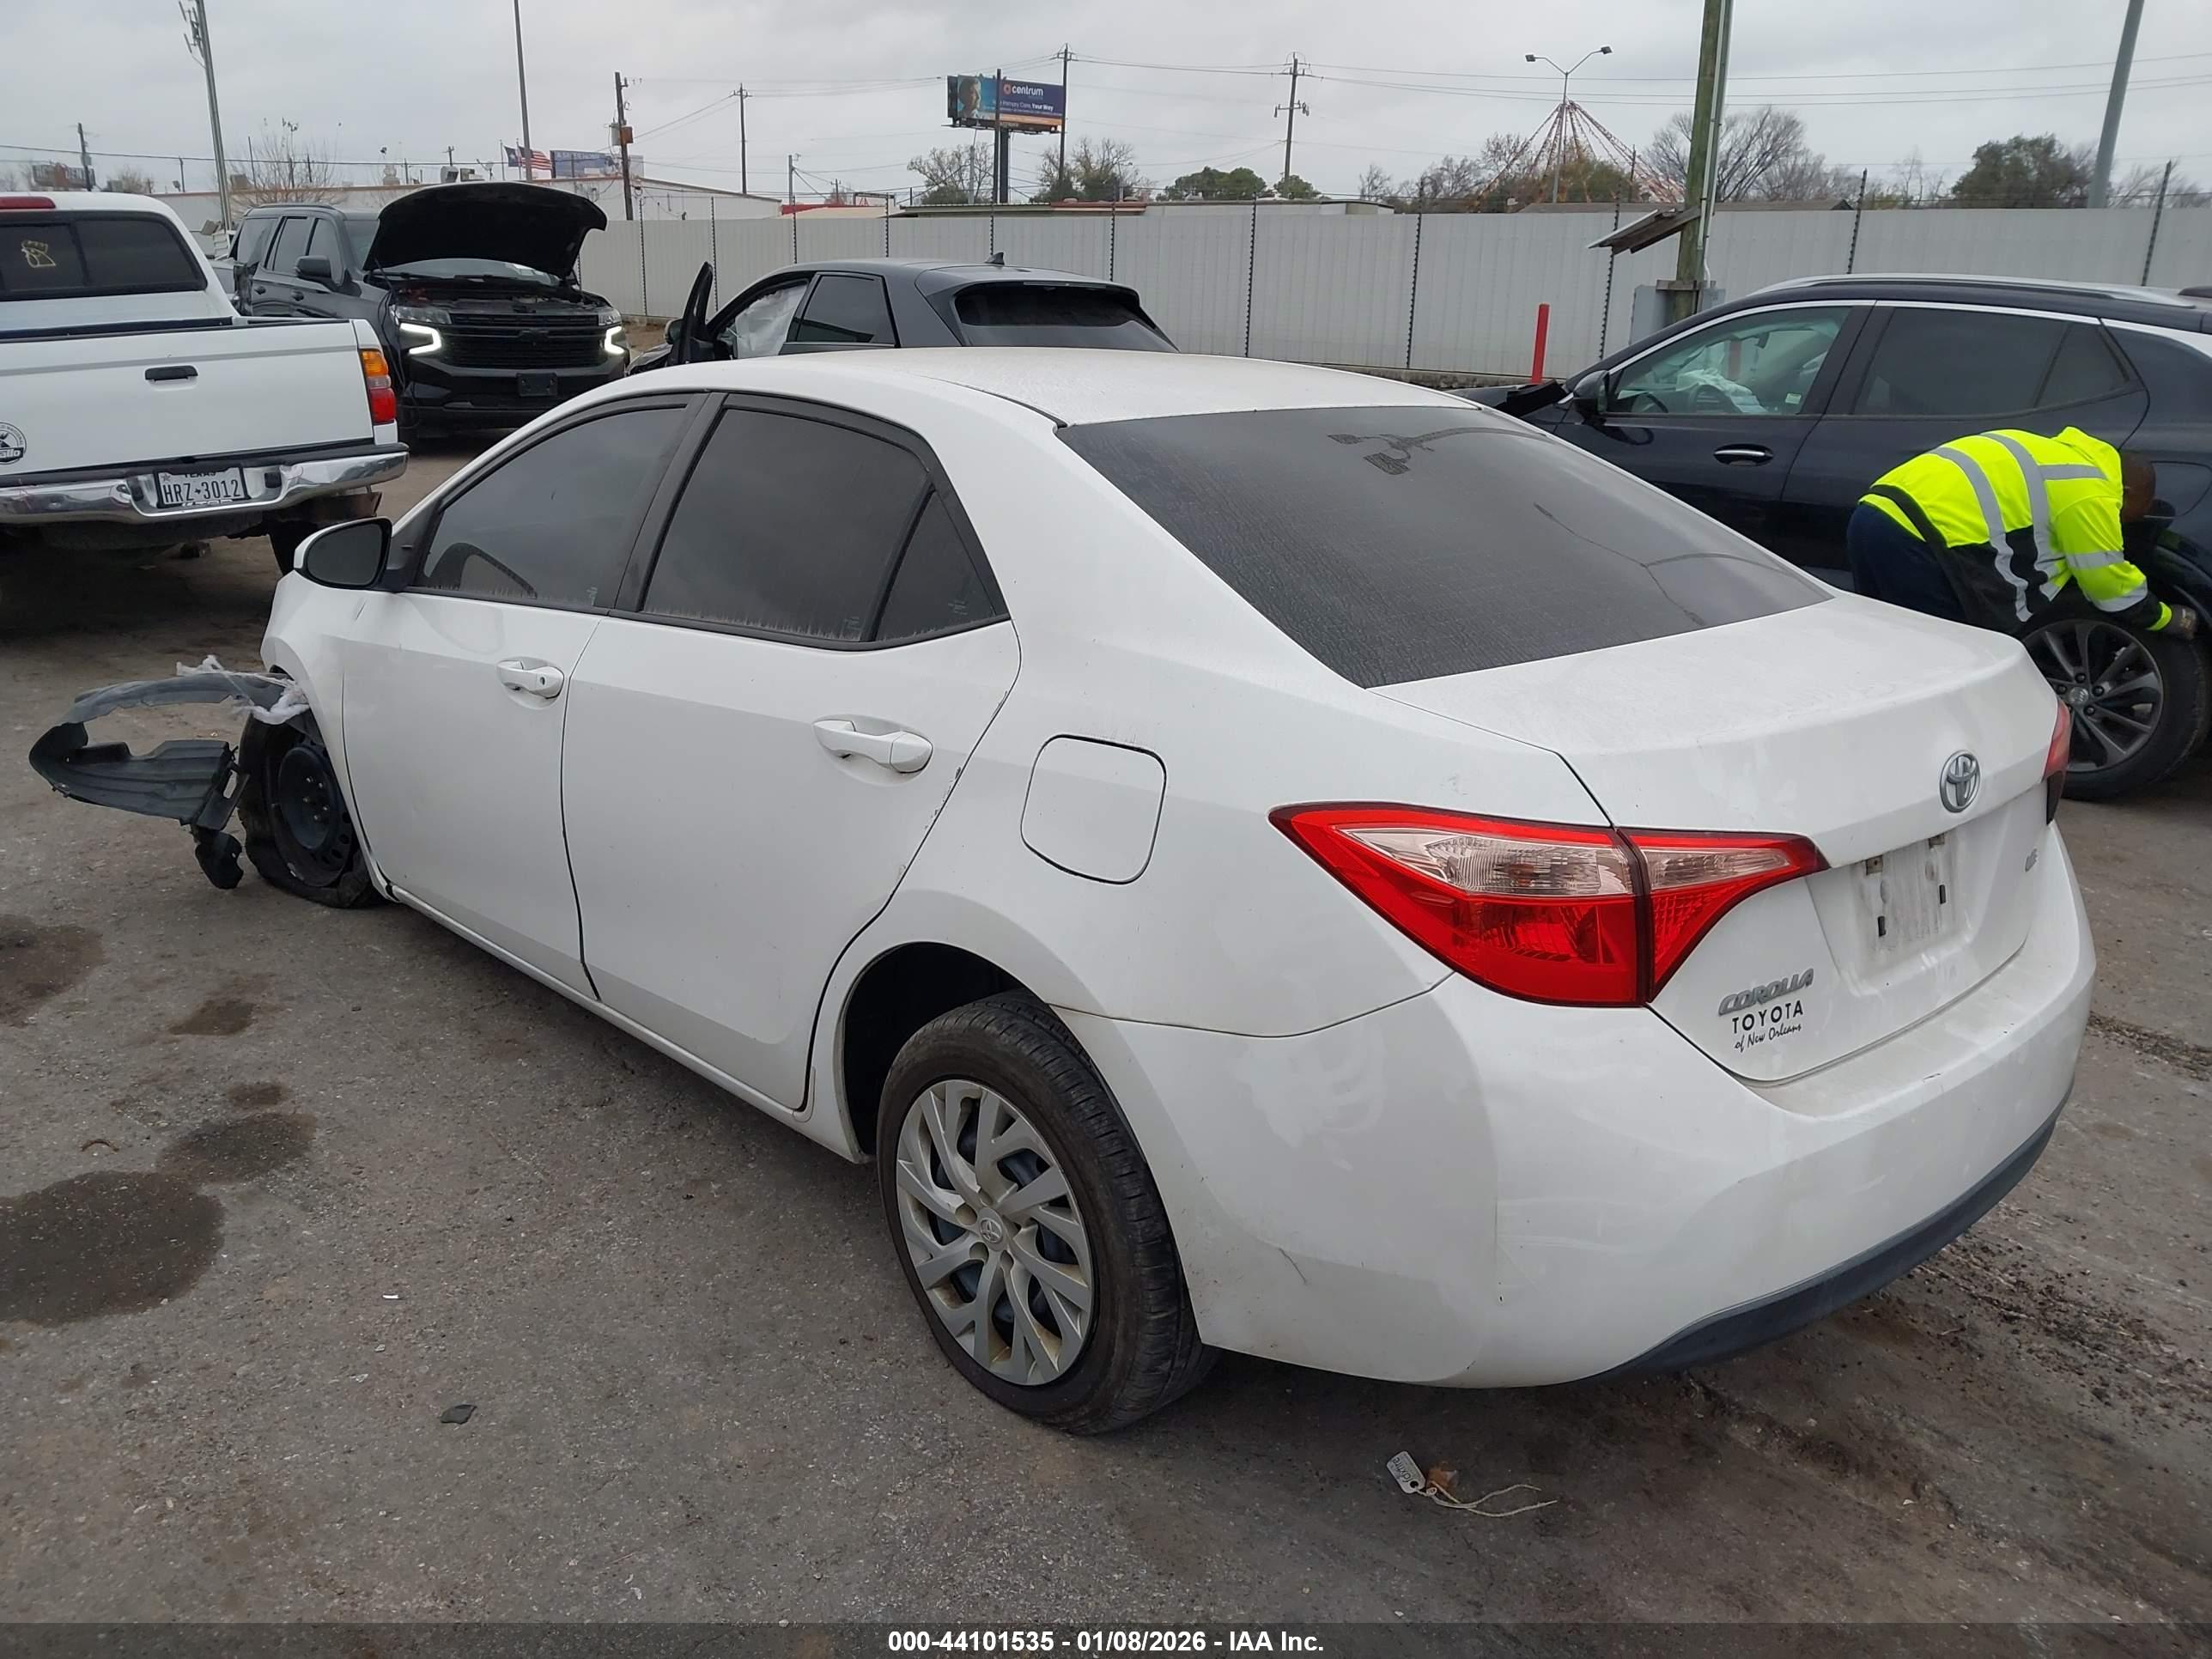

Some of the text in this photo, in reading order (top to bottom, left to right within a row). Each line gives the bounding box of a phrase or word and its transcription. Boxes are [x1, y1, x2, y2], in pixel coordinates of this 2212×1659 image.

[1012, 85, 1044, 96] centrum
[1718, 968, 1814, 1017] COROLLA
[1731, 1000, 1803, 1034] TOYOTA
[1734, 1023, 1802, 1053] of New Orleans
